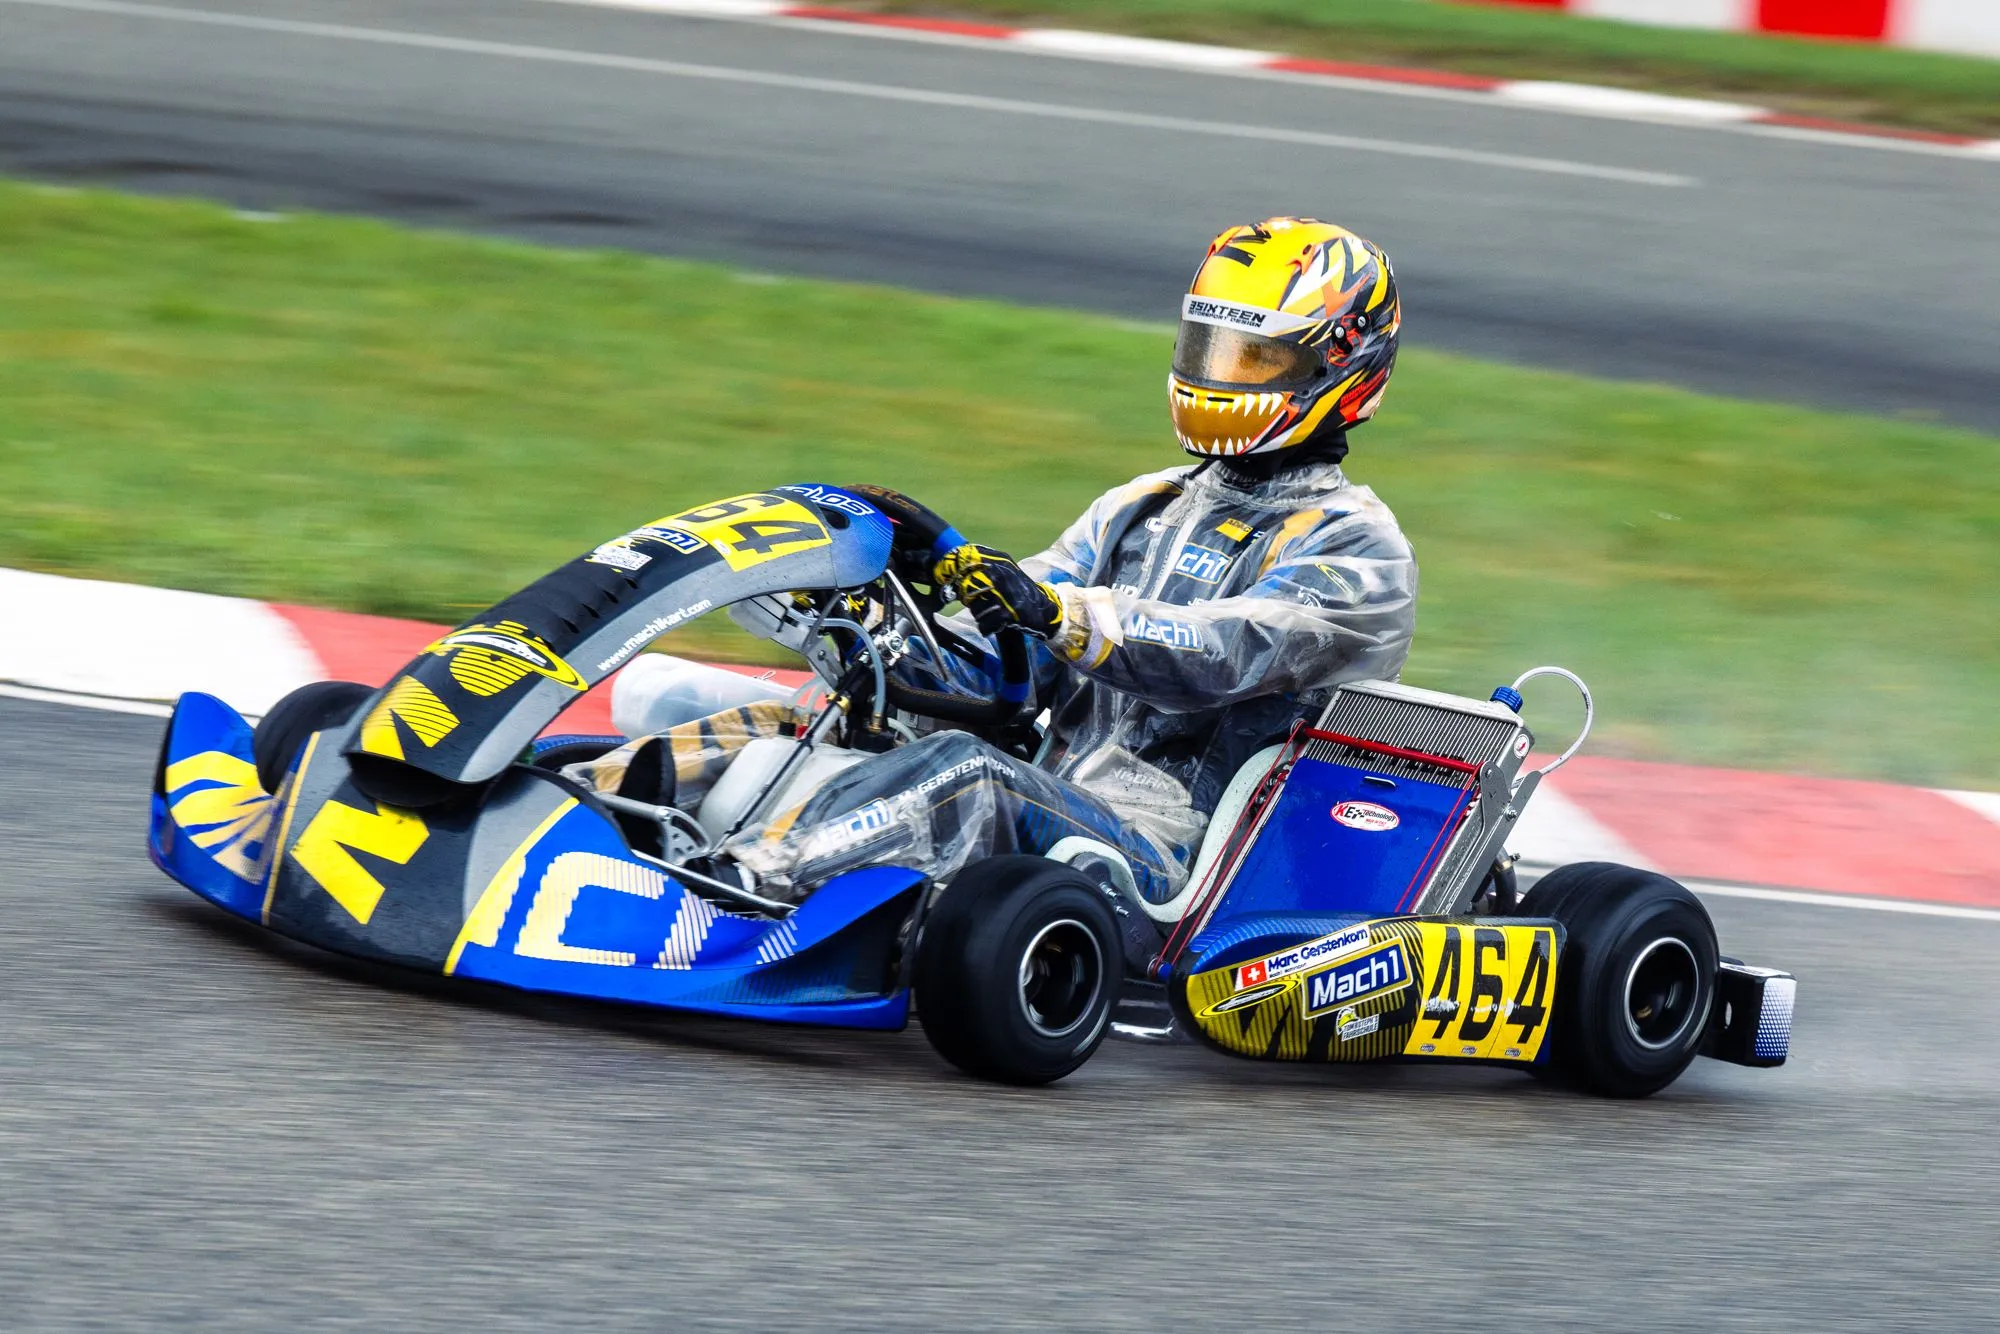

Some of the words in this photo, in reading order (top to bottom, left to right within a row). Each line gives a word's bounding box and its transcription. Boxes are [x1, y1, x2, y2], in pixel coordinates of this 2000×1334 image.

[1175, 551, 1229, 580] ch1
[1268, 952, 1299, 972] Marc
[1312, 948, 1399, 1009] Mach1
[1422, 926, 1551, 1044] 464
